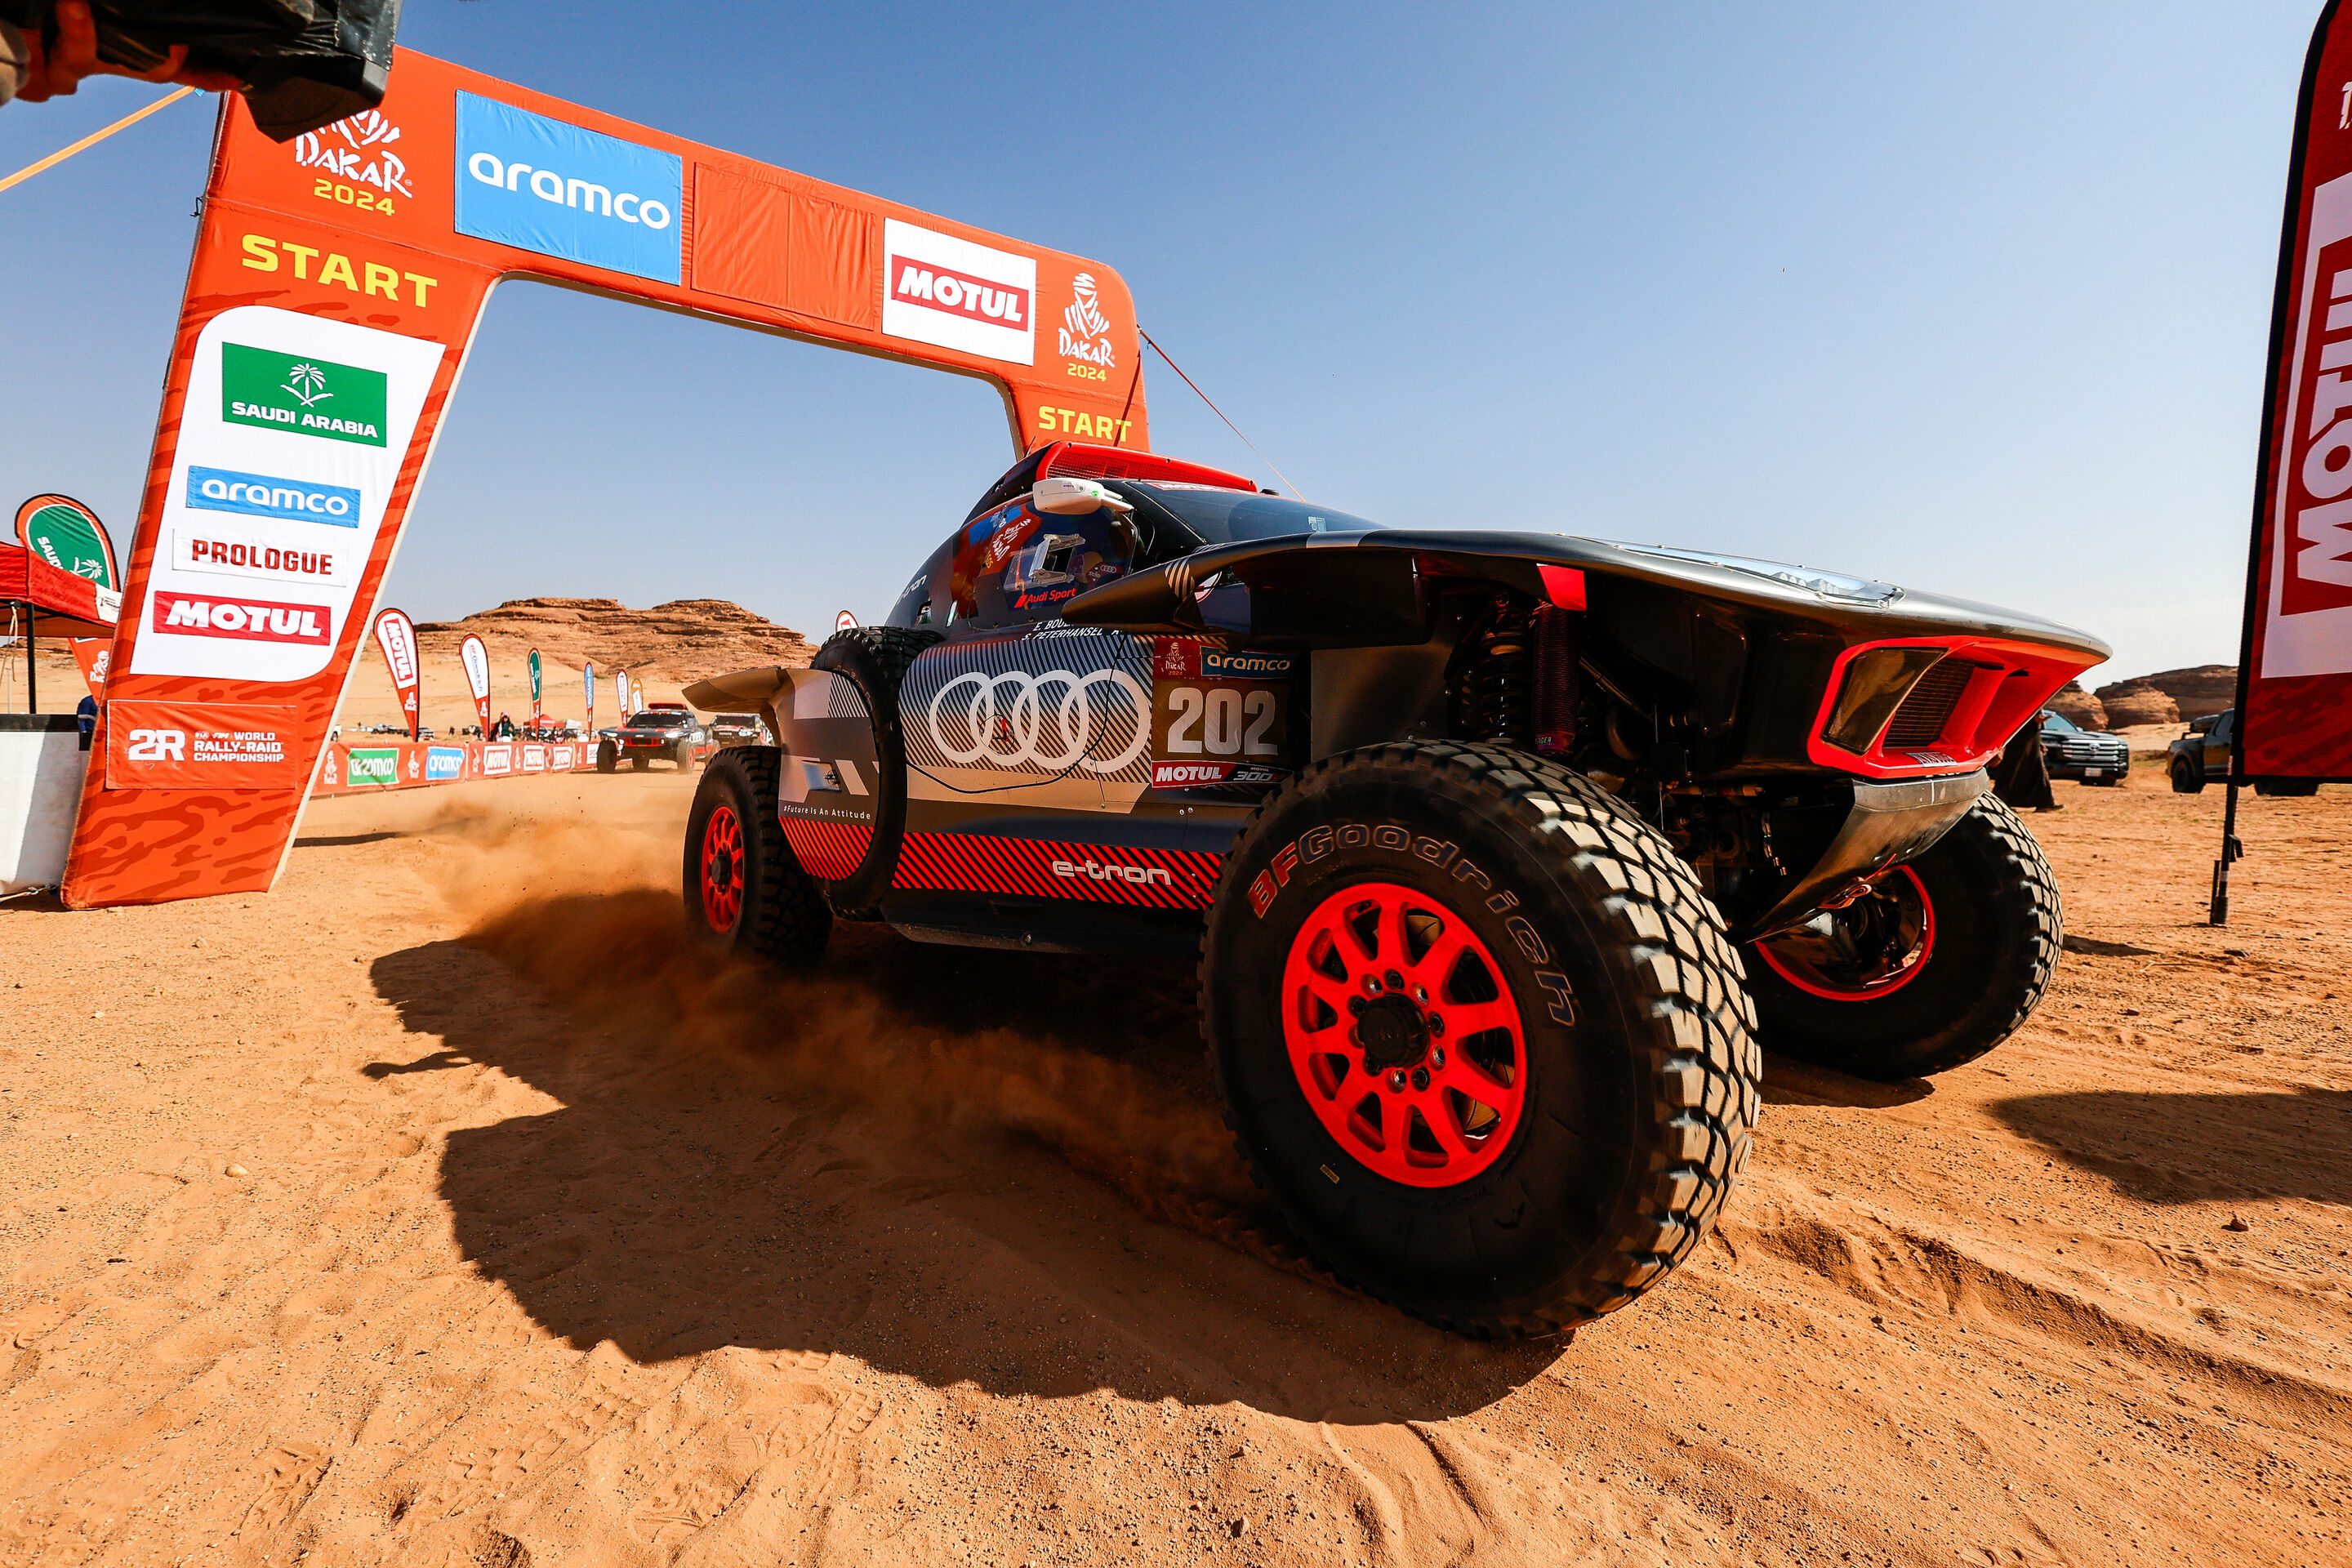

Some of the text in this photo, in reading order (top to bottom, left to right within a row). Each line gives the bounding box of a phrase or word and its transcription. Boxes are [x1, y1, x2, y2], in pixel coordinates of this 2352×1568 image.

[296, 131, 412, 198] DAKAR
[314, 177, 395, 216] 2024
[469, 150, 671, 230] aramco
[242, 234, 439, 309] START
[898, 266, 1022, 323] MOTUL
[1058, 327, 1116, 368] DAKAR
[1067, 363, 1107, 382] 2024
[231, 400, 379, 439] SAUDI ARABIA
[1038, 405, 1133, 443] START
[2297, 269, 2352, 587] MOT
[201, 477, 350, 517] aramco
[191, 538, 333, 576] PROLOGUE
[1027, 587, 1077, 604] Audi Sport
[164, 599, 323, 639] MOTUL
[1032, 627, 1103, 640] PETERHANSEL
[385, 621, 412, 680] MOTUL
[1207, 653, 1290, 671] aramco
[234, 732, 275, 741] WORLD
[1167, 687, 1279, 756] 202
[194, 741, 282, 753] RALLY-RAID
[194, 752, 284, 762] CHAMPIONSHIP
[429, 755, 463, 773] aramco
[1156, 766, 1223, 782] MOTUL
[783, 804, 871, 820] #Future Is An Attitude
[1052, 858, 1173, 886] e-tron
